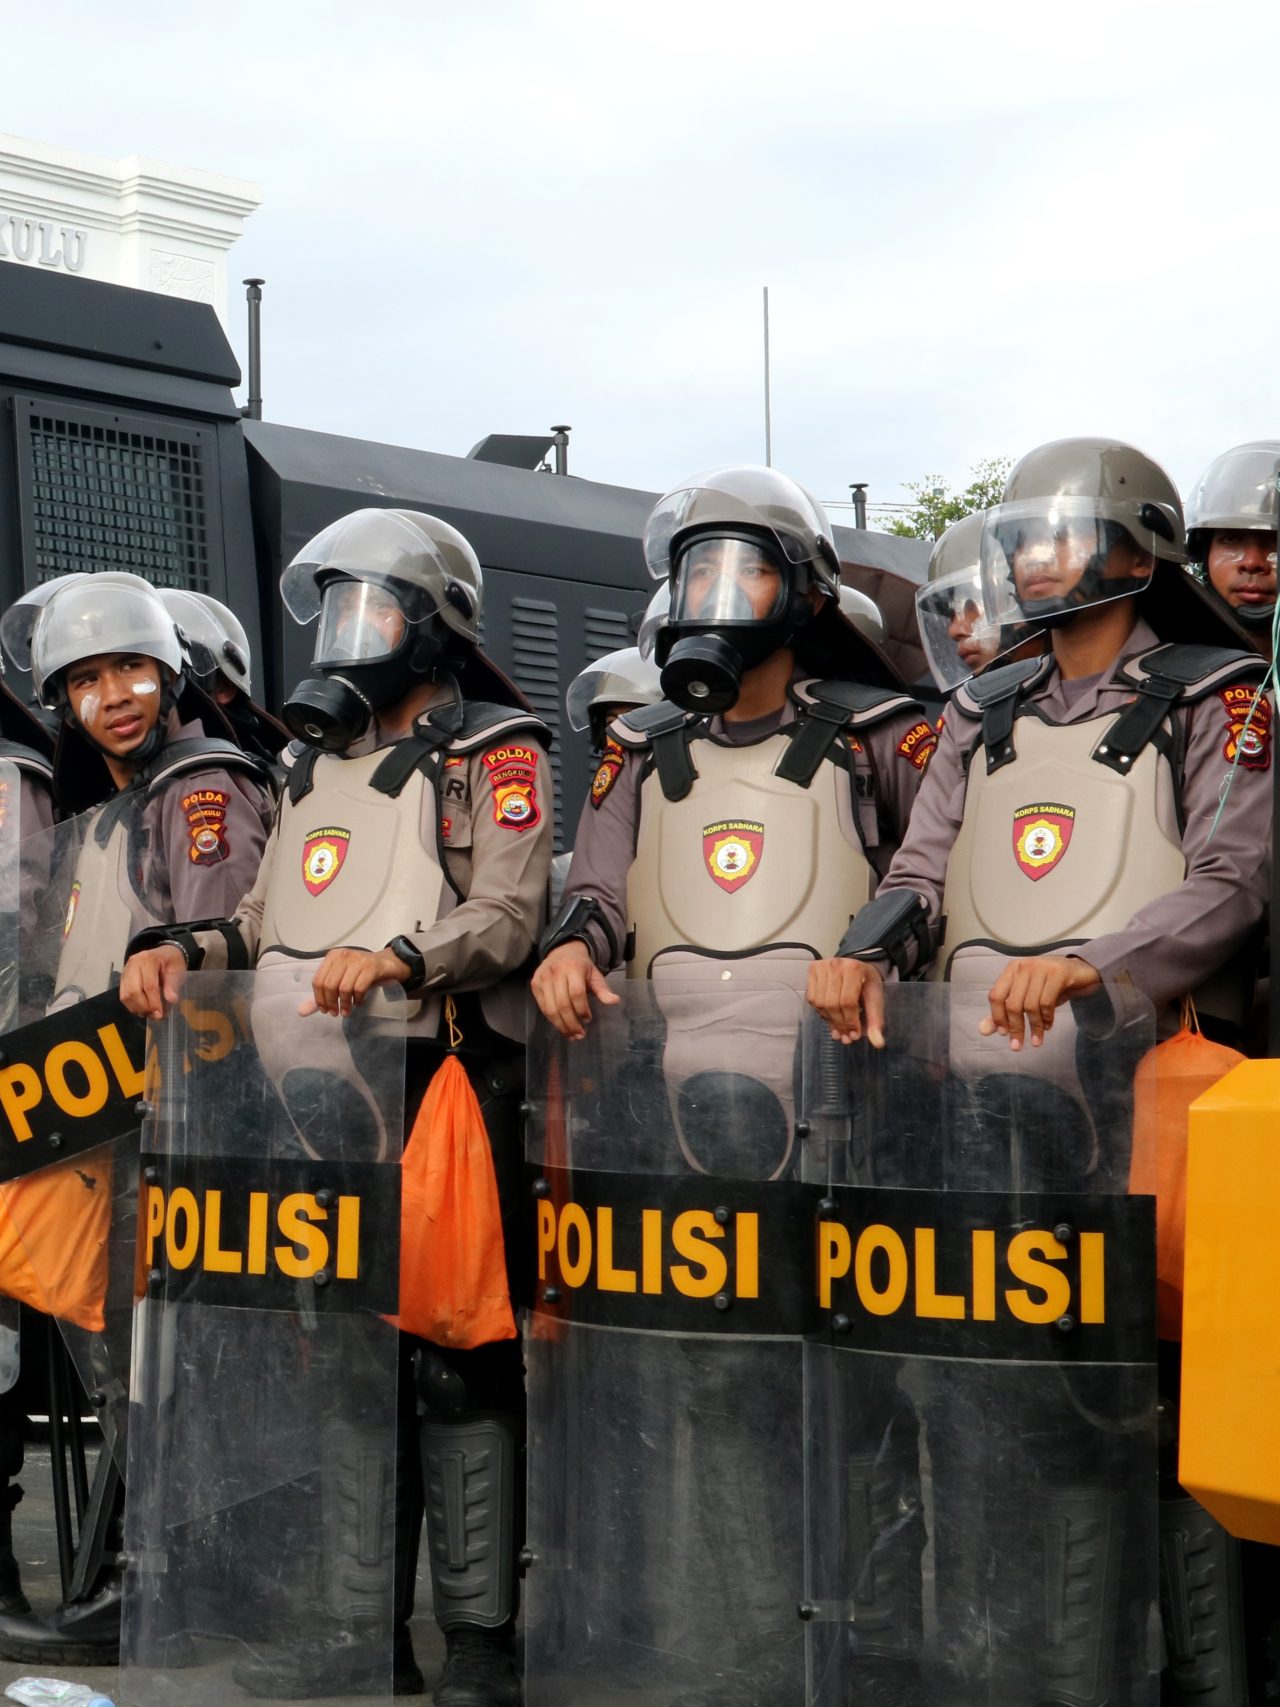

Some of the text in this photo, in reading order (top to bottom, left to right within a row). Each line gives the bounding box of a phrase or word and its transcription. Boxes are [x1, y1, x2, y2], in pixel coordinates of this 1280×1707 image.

[1224, 688, 1268, 707] POLDA
[901, 723, 931, 754] POLDA
[487, 748, 533, 766] POLDA
[183, 791, 223, 808] POLDA
[1014, 805, 1074, 819] KORPS SABHARA
[703, 822, 764, 836] KORPS SABHARA
[147, 1186, 360, 1280] POLISI
[537, 1199, 759, 1299] POLISI
[819, 1221, 1106, 1324] POLISI
